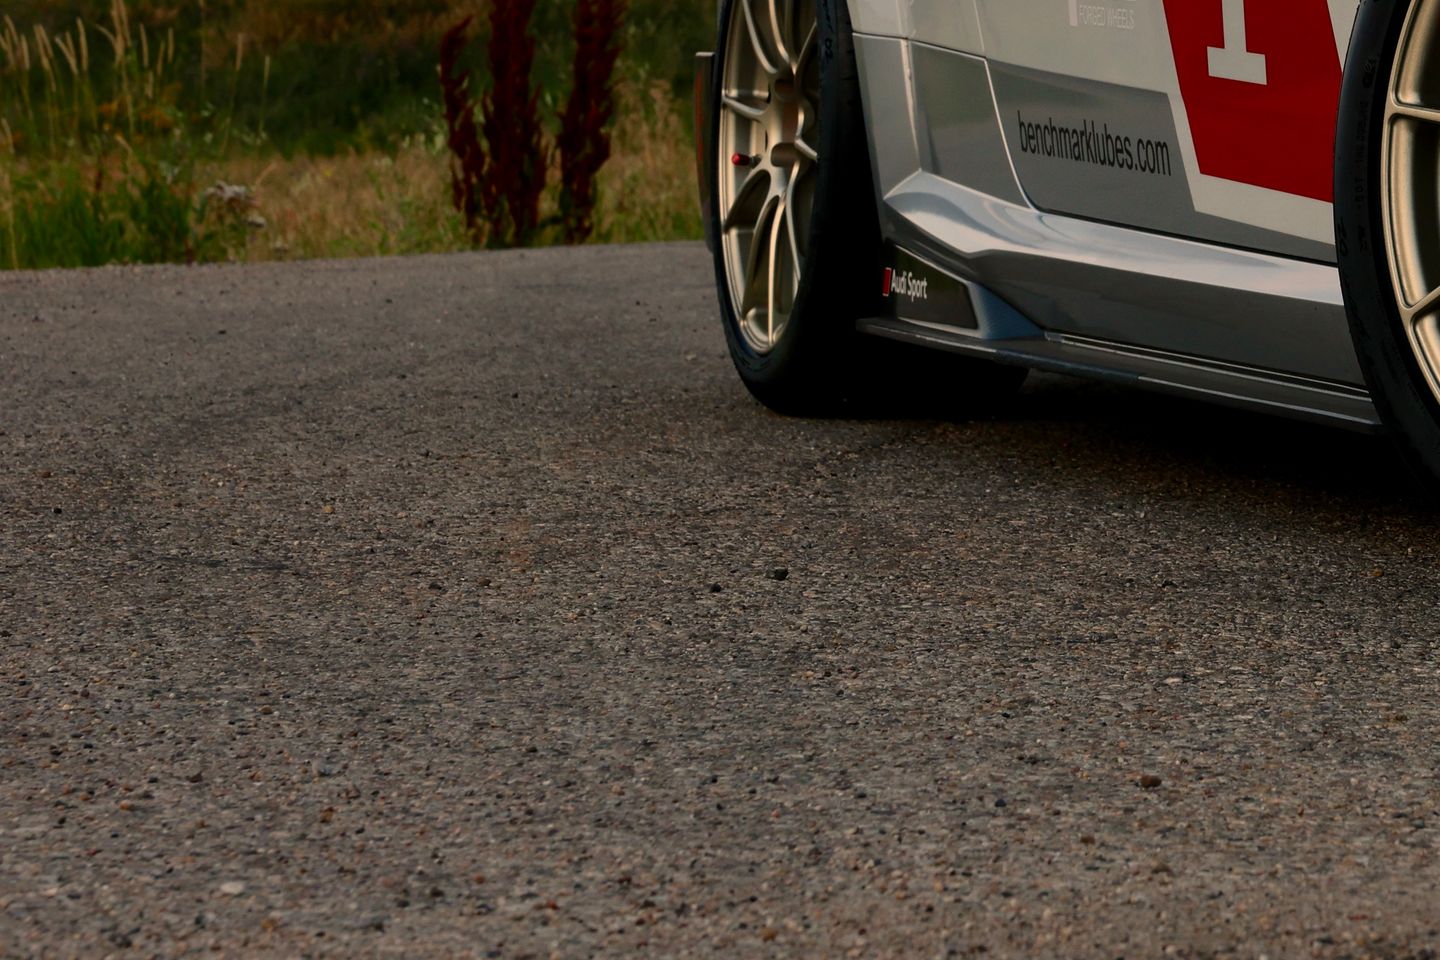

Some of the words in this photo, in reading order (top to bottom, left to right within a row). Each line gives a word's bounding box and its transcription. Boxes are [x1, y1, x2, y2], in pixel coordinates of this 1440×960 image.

[1017, 110, 1171, 176] benchmarklubes.com
[891, 269, 907, 295] Audi
[907, 271, 928, 302] Sport
